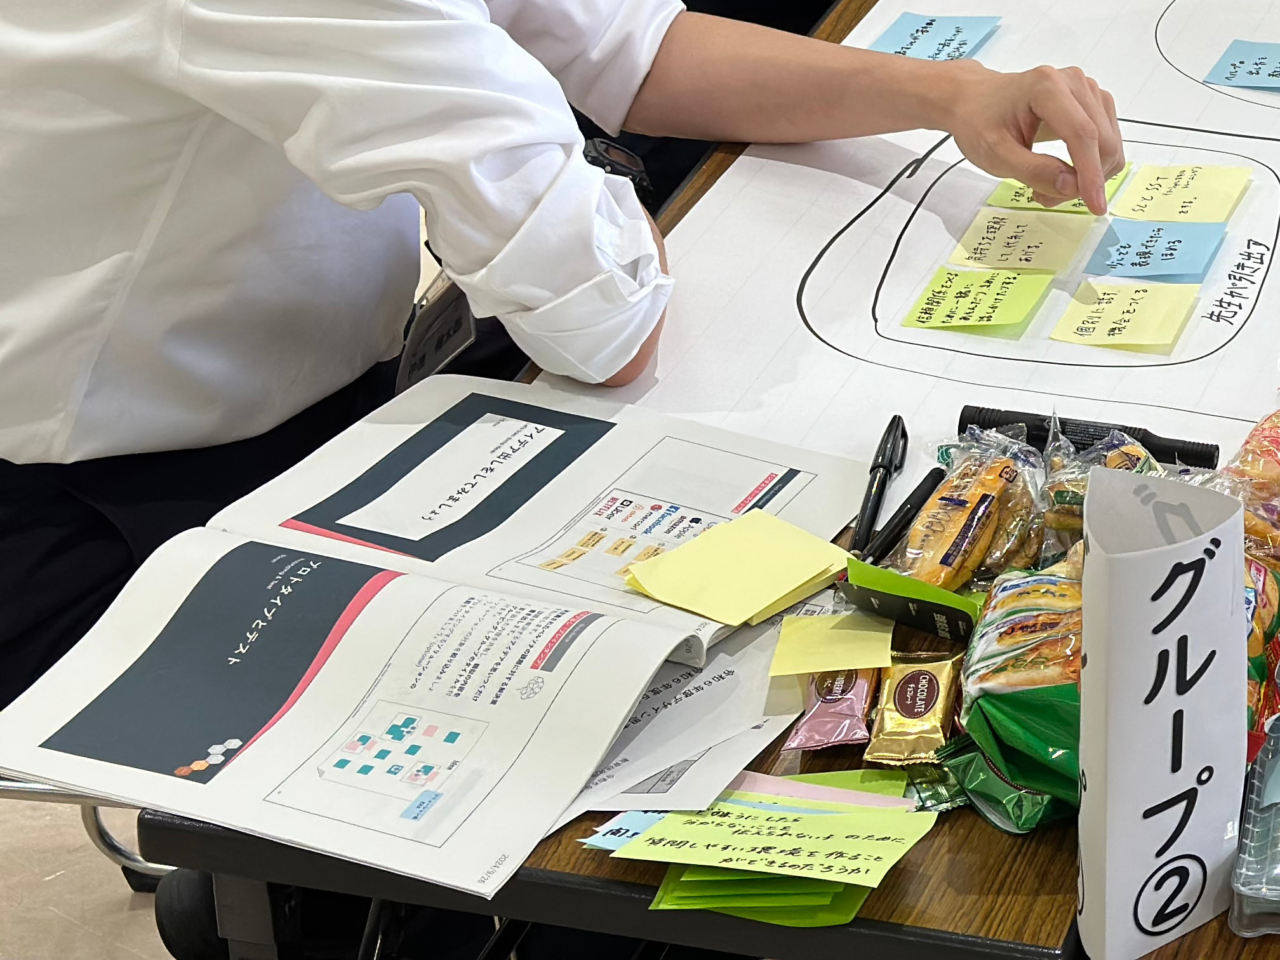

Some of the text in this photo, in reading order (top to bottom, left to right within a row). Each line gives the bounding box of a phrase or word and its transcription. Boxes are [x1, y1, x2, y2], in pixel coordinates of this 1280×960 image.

[965, 217, 1007, 260] 気持ちを理解
[1106, 244, 1131, 269] 少しでも
[1130, 228, 1163, 267] 表現できたら
[1161, 240, 1182, 260] ほめる
[1202, 239, 1273, 326] 先生が引き出す
[1107, 289, 1147, 336] 機会をつくる
[421, 426, 546, 521] アイデア出しをしてみましょう
[227, 560, 322, 665] プロトタイプとテスト
[914, 675, 930, 714] CHOCOLATE
[1134, 537, 1223, 936] グループ②
